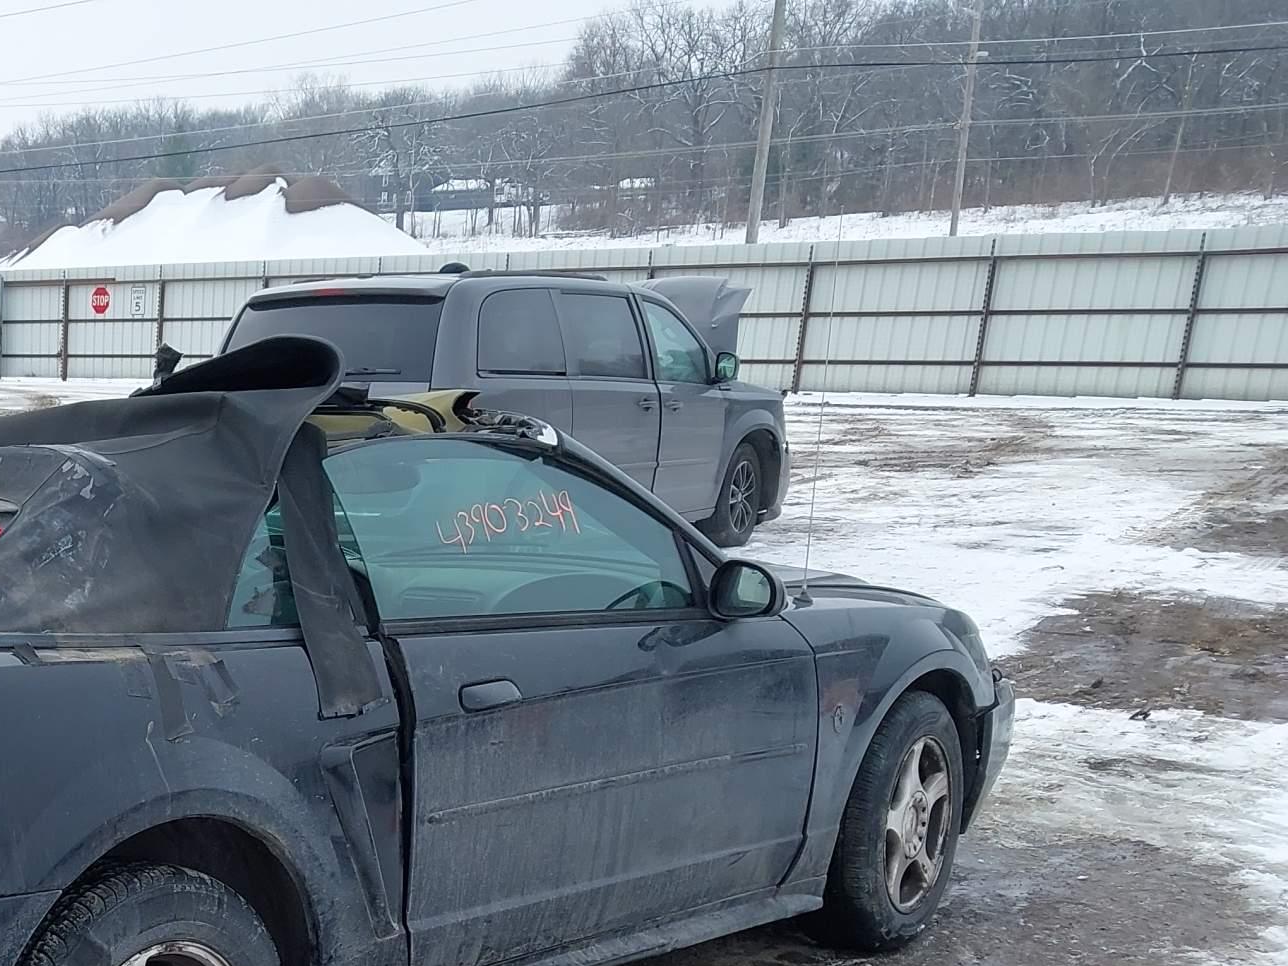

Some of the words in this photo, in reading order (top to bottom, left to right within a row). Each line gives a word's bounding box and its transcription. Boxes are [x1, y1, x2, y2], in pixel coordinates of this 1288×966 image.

[92, 295, 110, 307] STOP
[134, 301, 141, 312] 5
[435, 489, 581, 554] 43903249
